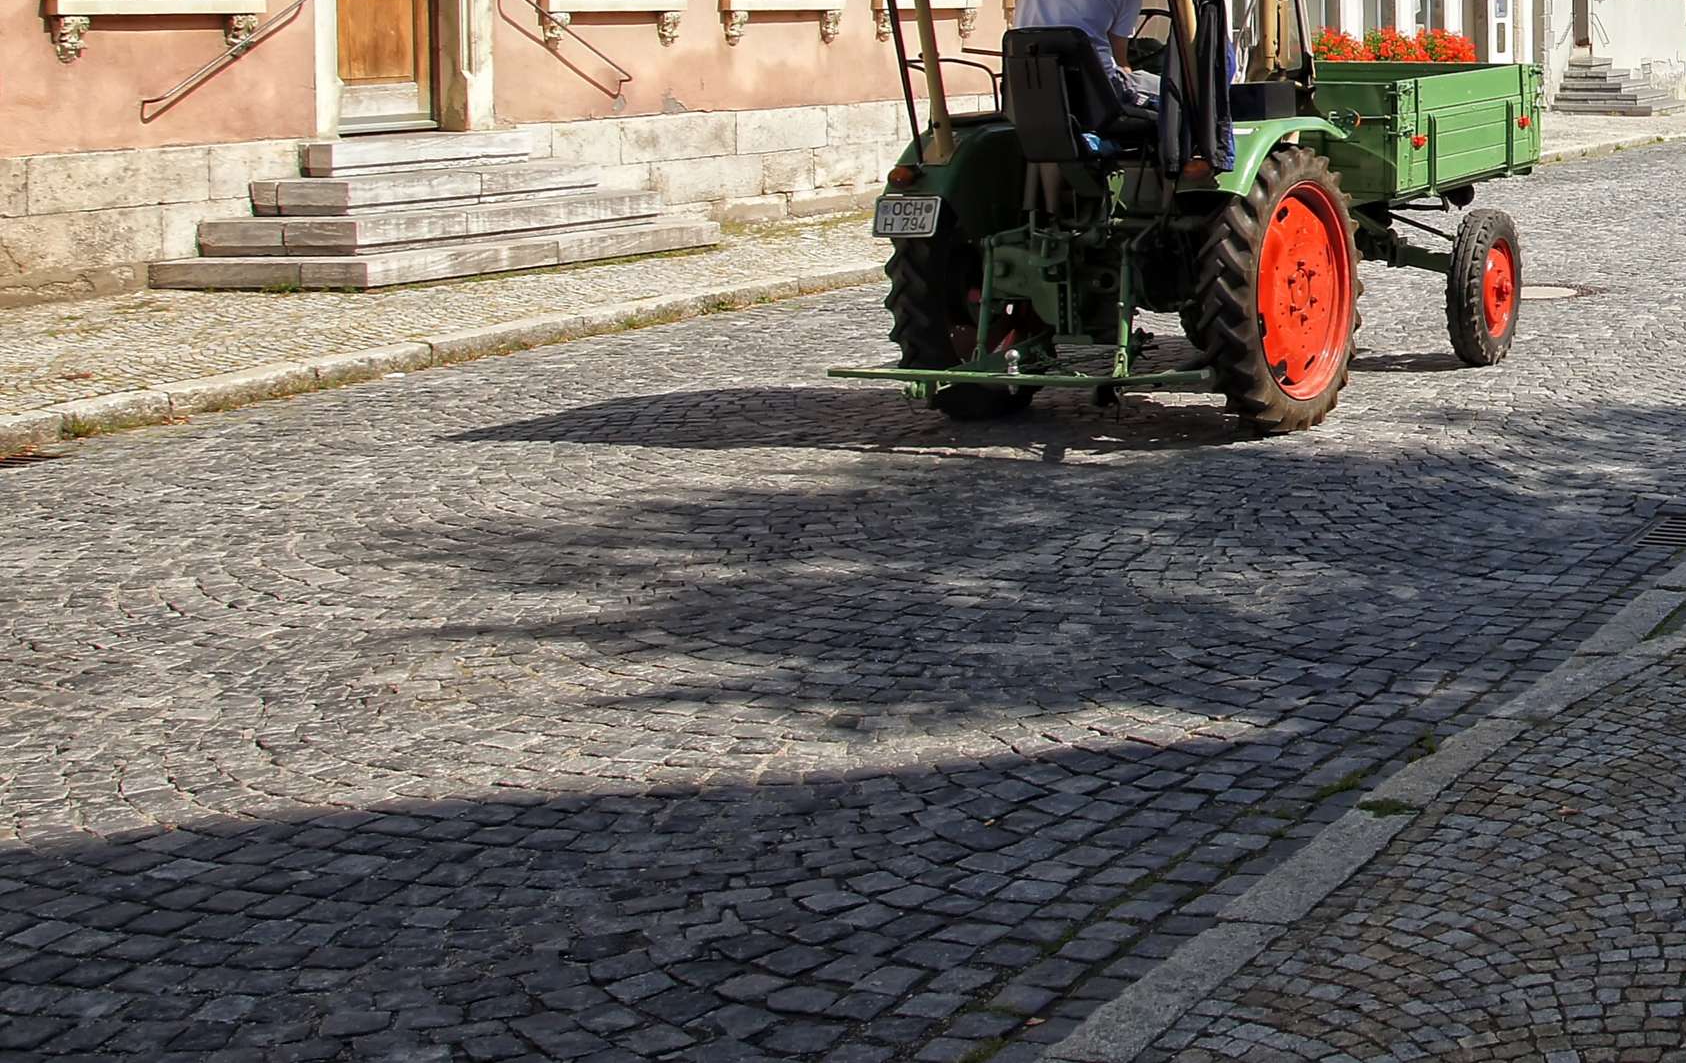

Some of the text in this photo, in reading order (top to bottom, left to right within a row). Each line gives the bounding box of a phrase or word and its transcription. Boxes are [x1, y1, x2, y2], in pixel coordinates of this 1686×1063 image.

[892, 201, 924, 216] OCH
[883, 217, 926, 231] H 794
